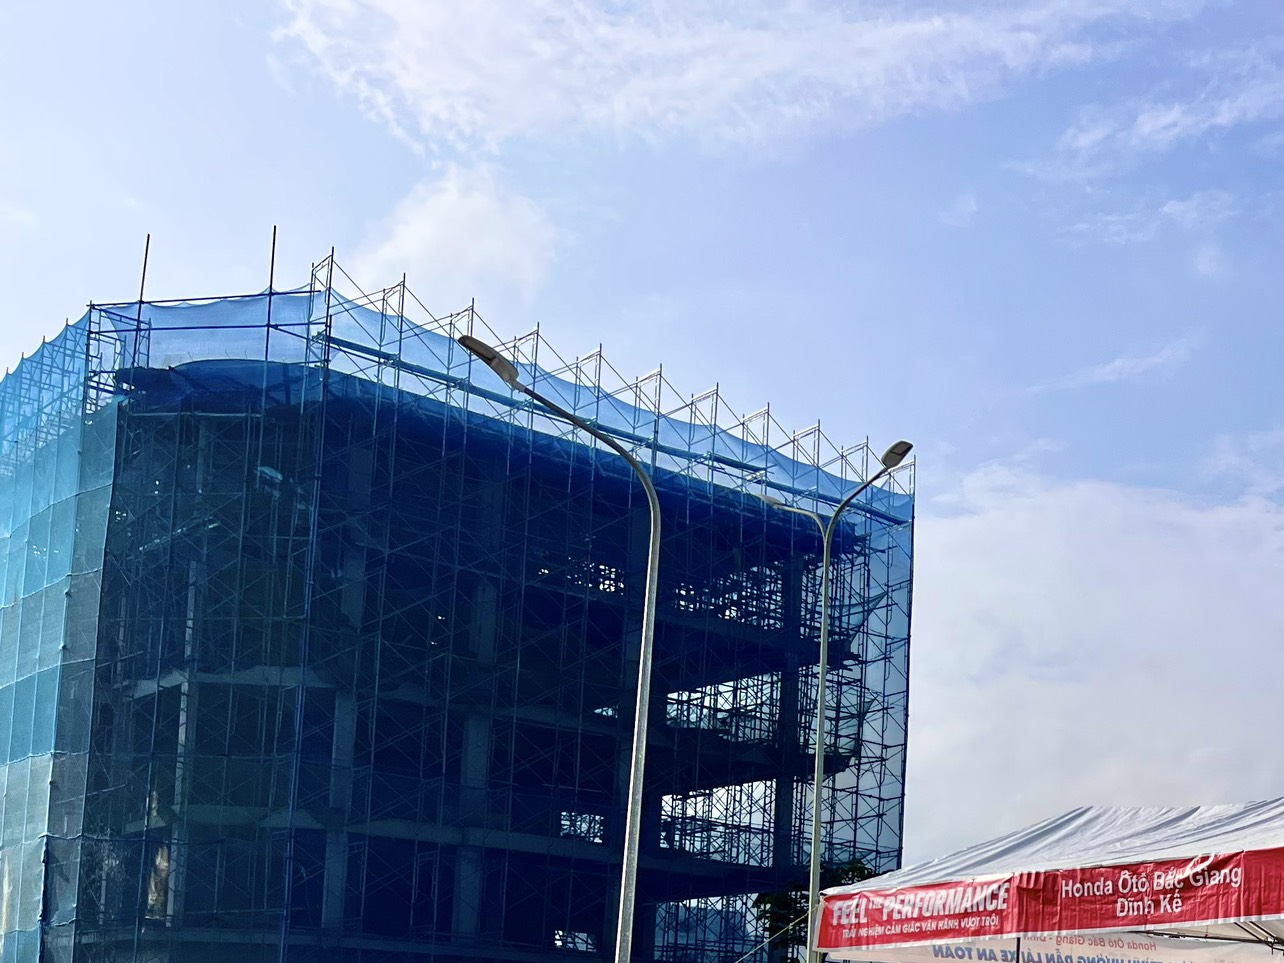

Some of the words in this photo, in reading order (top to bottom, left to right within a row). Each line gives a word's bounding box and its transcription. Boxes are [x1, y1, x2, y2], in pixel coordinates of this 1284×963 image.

[1062, 877, 1113, 898] Honda
[1118, 870, 1149, 894] Ôtô
[1153, 866, 1184, 891] Bắc
[1189, 866, 1242, 888] Giang
[833, 896, 868, 926] FEEL
[883, 882, 1010, 921] PERFORMANCE
[1116, 897, 1155, 917] Dĩnh
[1160, 889, 1182, 914] Kế
[886, 921, 901, 935] CẢM
[902, 920, 920, 933] GIÁC
[922, 919, 936, 934] VẬN
[938, 918, 958, 930] HÀNH
